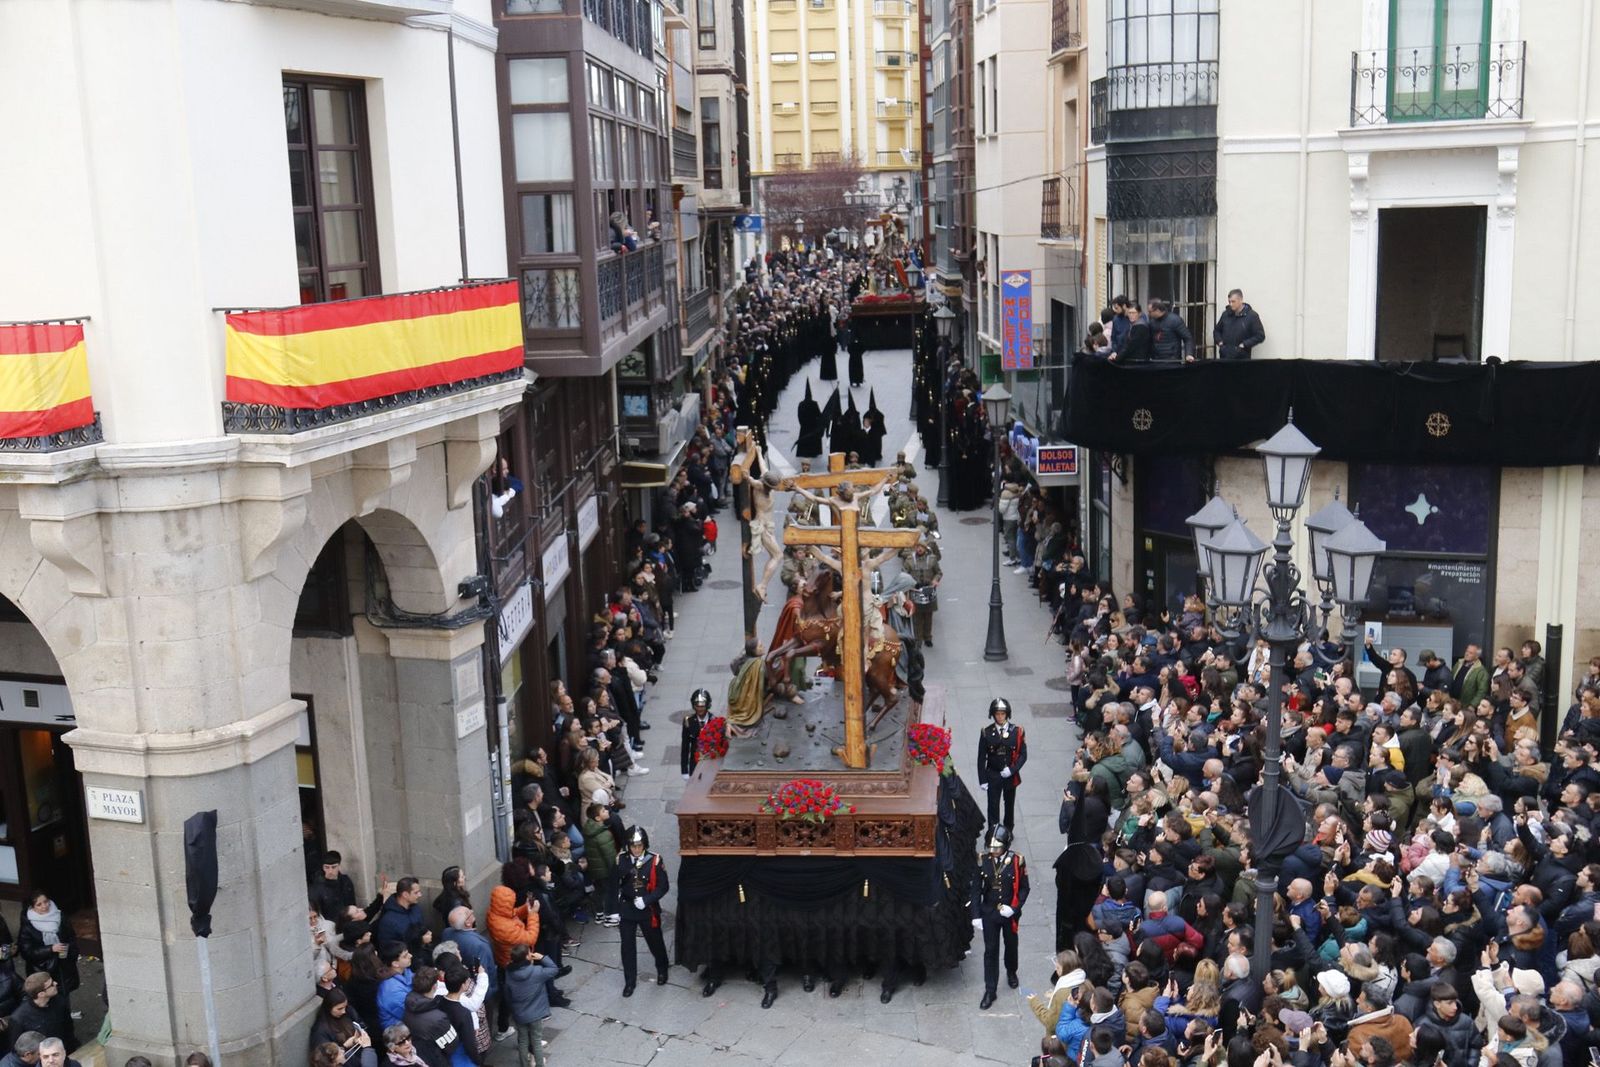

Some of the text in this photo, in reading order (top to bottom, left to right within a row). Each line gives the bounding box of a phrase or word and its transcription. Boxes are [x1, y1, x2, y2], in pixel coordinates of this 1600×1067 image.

[1004, 298, 1017, 368] MALETAS
[1018, 296, 1031, 368] BOLSOS
[1041, 451, 1073, 460] BOLSOS
[1040, 463, 1076, 472] MALETAS
[1428, 563, 1480, 572] #mantenimiento
[102, 793, 134, 804] PLAZA
[103, 805, 137, 816] MAYOR
